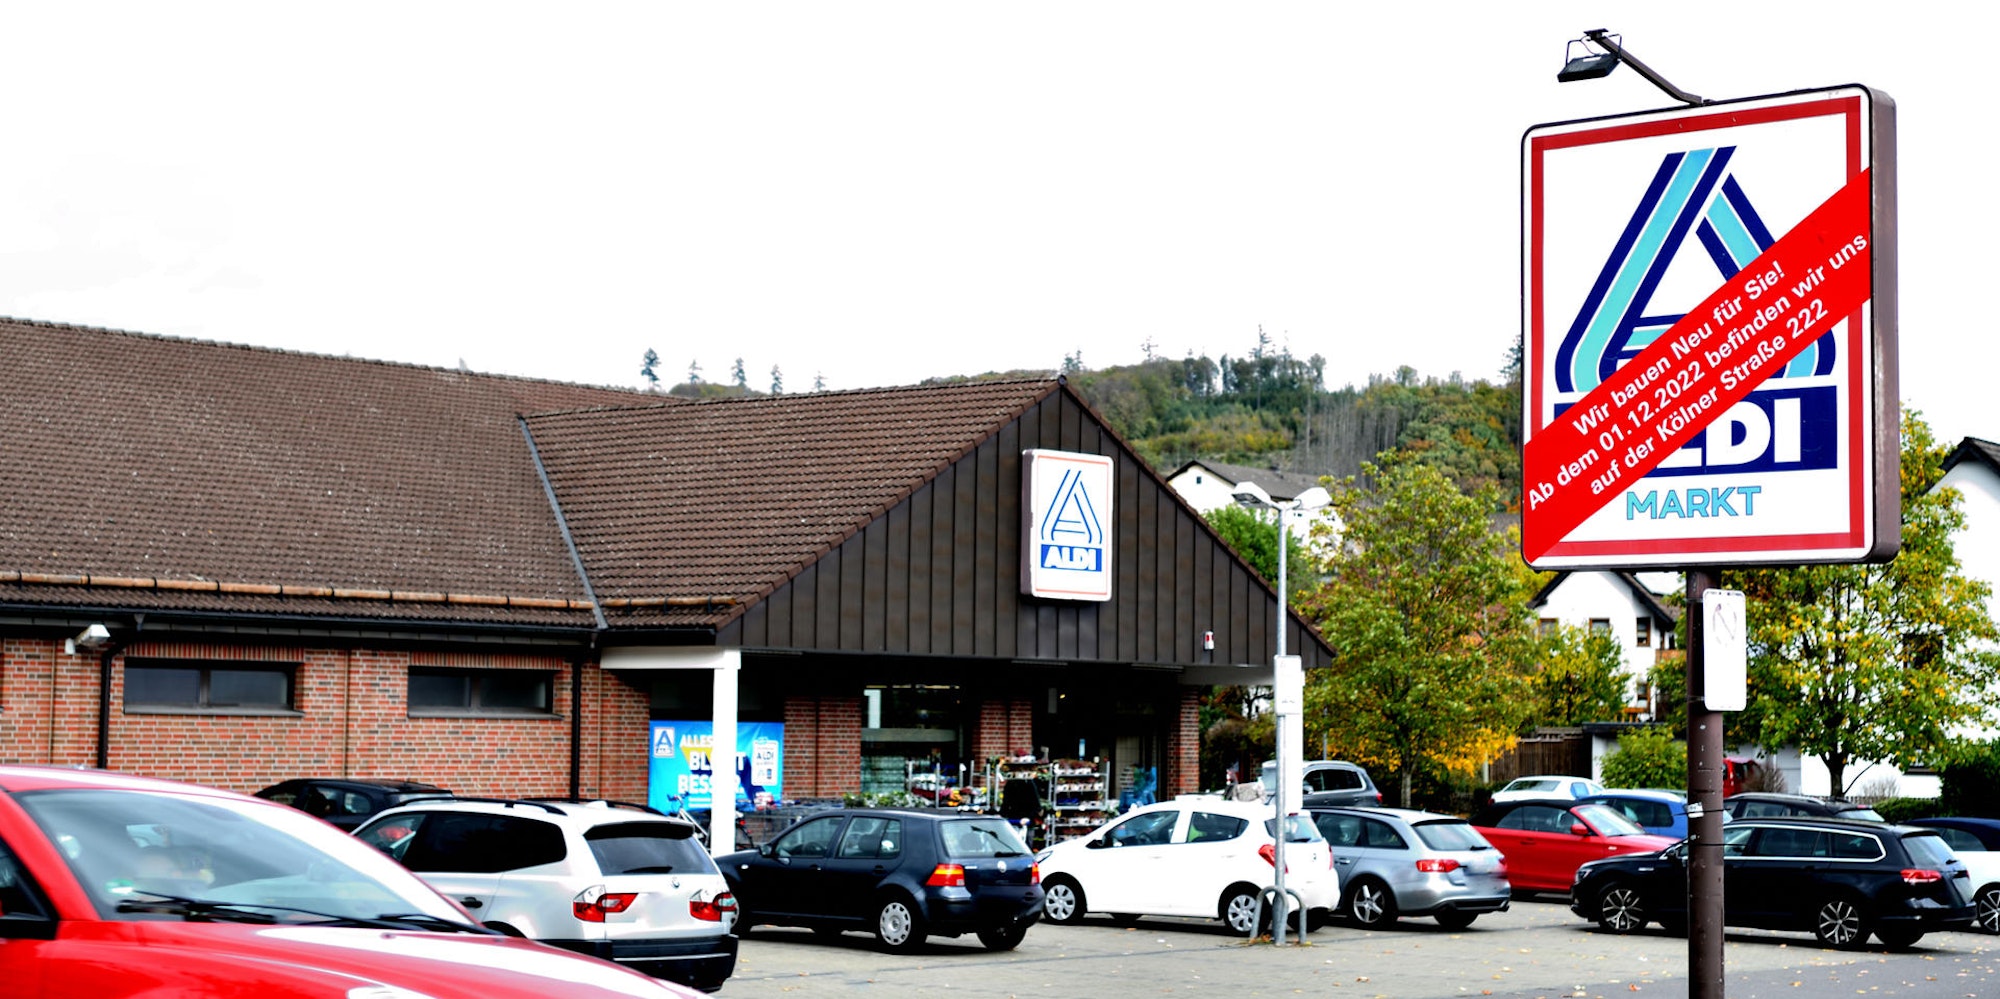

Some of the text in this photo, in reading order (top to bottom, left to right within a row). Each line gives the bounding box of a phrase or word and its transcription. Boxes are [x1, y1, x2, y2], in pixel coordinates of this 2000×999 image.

[1530, 236, 1867, 510] Ab dem 01.12.2022 befinden wir uns
[1573, 261, 1784, 435] Wir bauen Neu für Sie!
[1591, 299, 1828, 494] auf der Kölner Straße 222
[1657, 397, 1801, 468] DI
[1043, 546, 1097, 571] ALDI
[1626, 485, 1762, 520] MARKT
